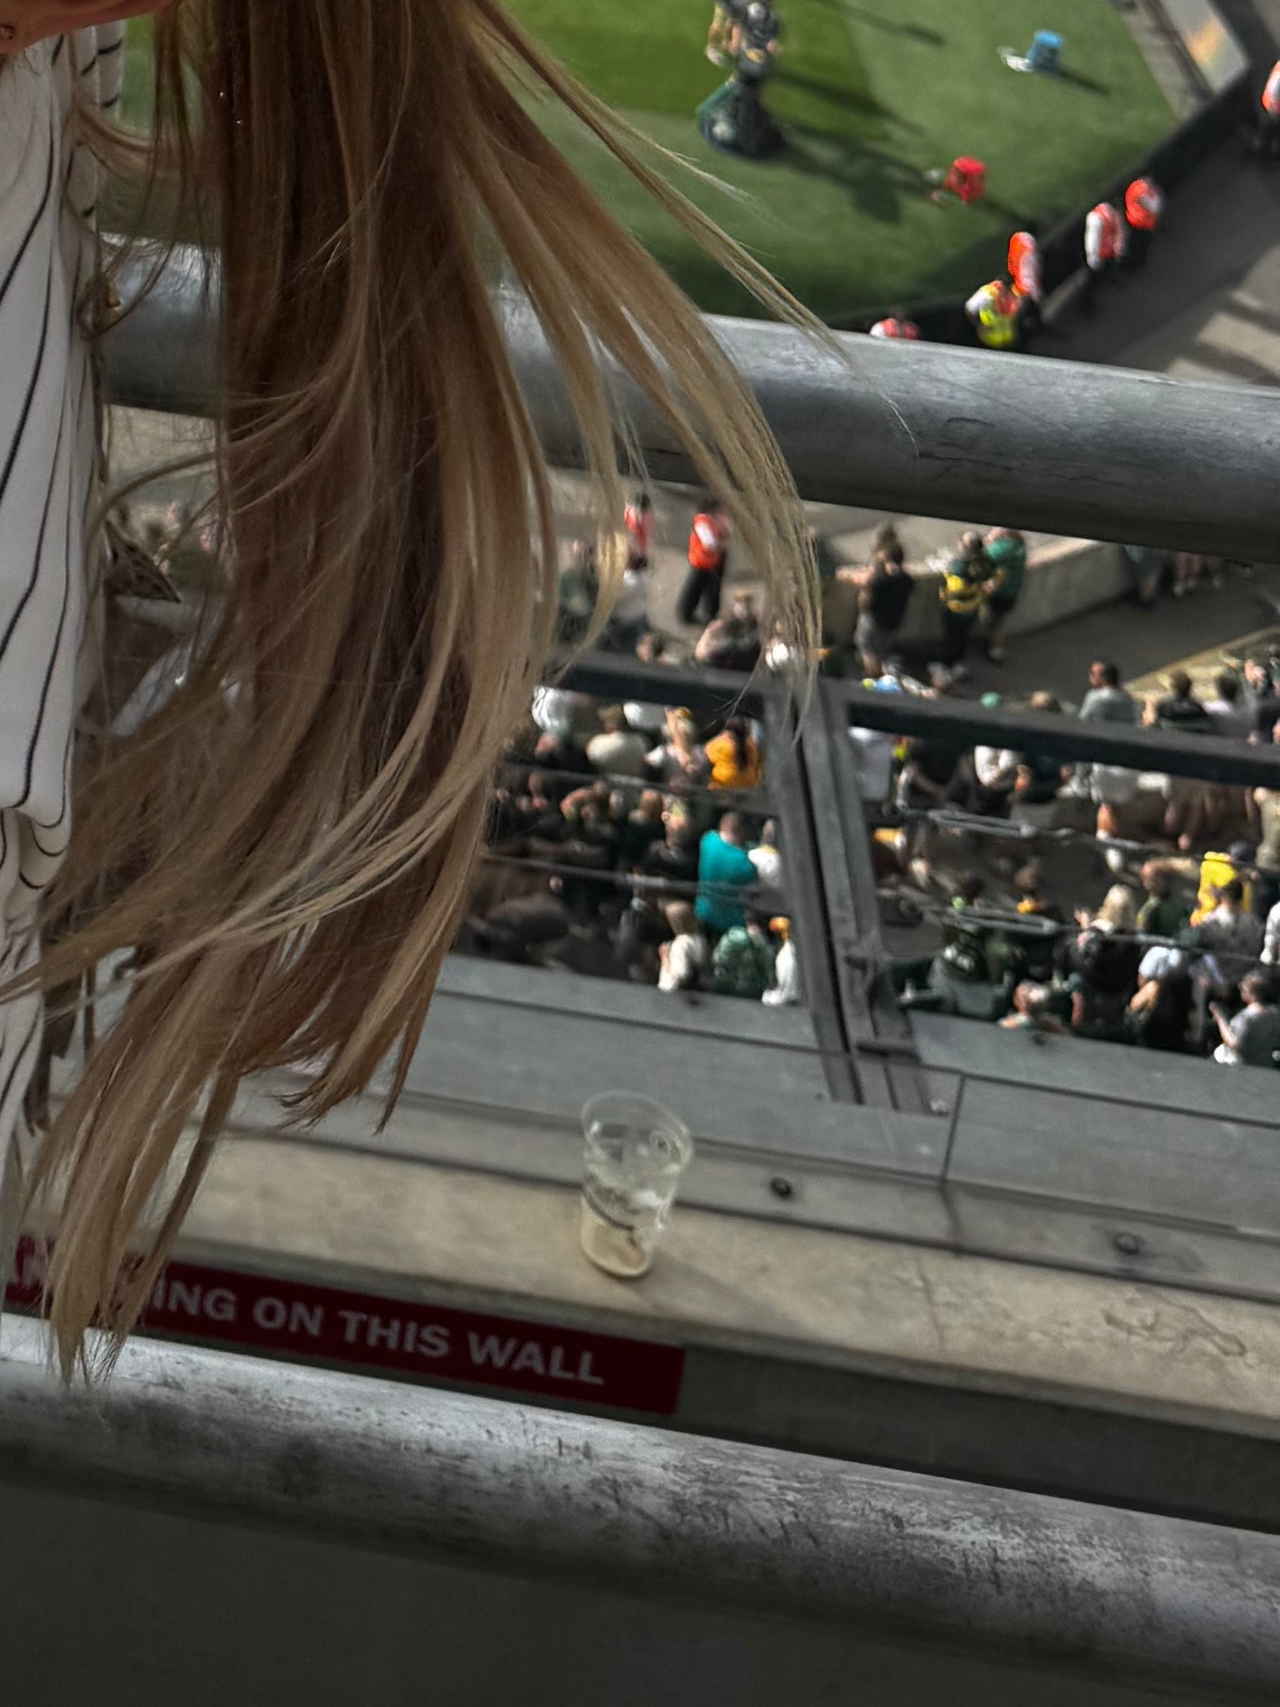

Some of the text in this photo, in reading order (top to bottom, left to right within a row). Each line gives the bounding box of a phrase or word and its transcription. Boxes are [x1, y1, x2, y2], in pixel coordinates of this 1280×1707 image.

[252, 1295, 324, 1336] ON
[338, 1309, 451, 1359] THIS
[467, 1331, 604, 1385] WALL
